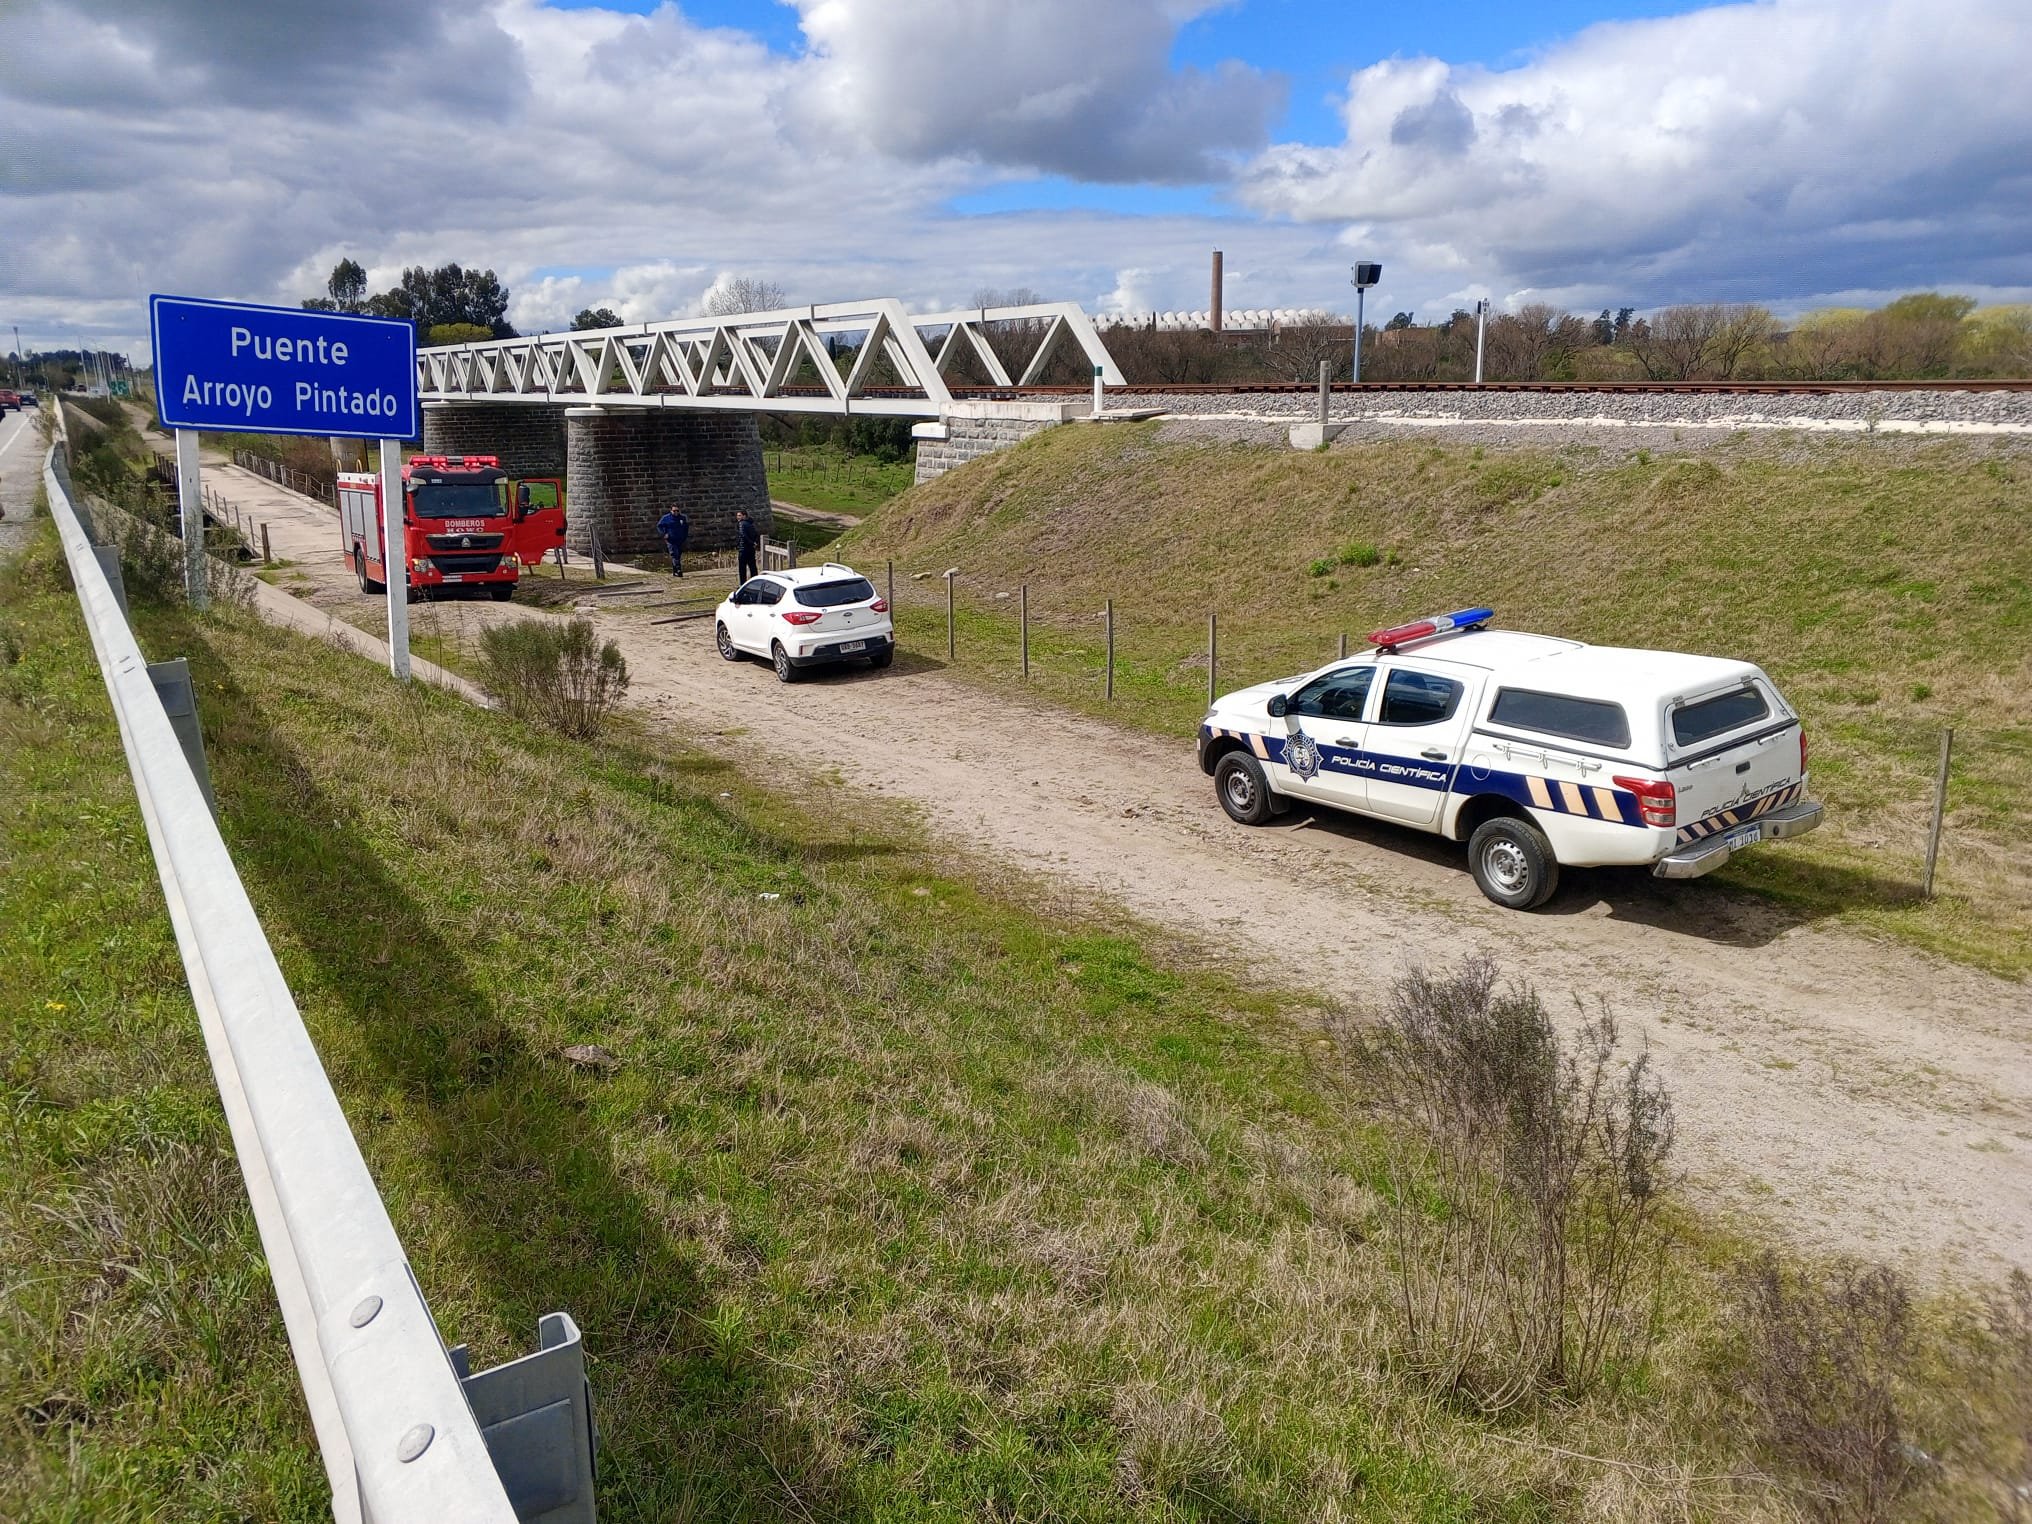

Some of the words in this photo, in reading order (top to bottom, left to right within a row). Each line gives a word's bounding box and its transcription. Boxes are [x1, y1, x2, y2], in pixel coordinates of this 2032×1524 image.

[231, 326, 349, 365] Puente
[182, 374, 272, 416] Arroyo
[295, 382, 397, 417] Pintado
[444, 519, 485, 528] BOMBEROS
[1331, 755, 1376, 770] POLICÍA
[1380, 763, 1447, 782] CIENTÍFICA
